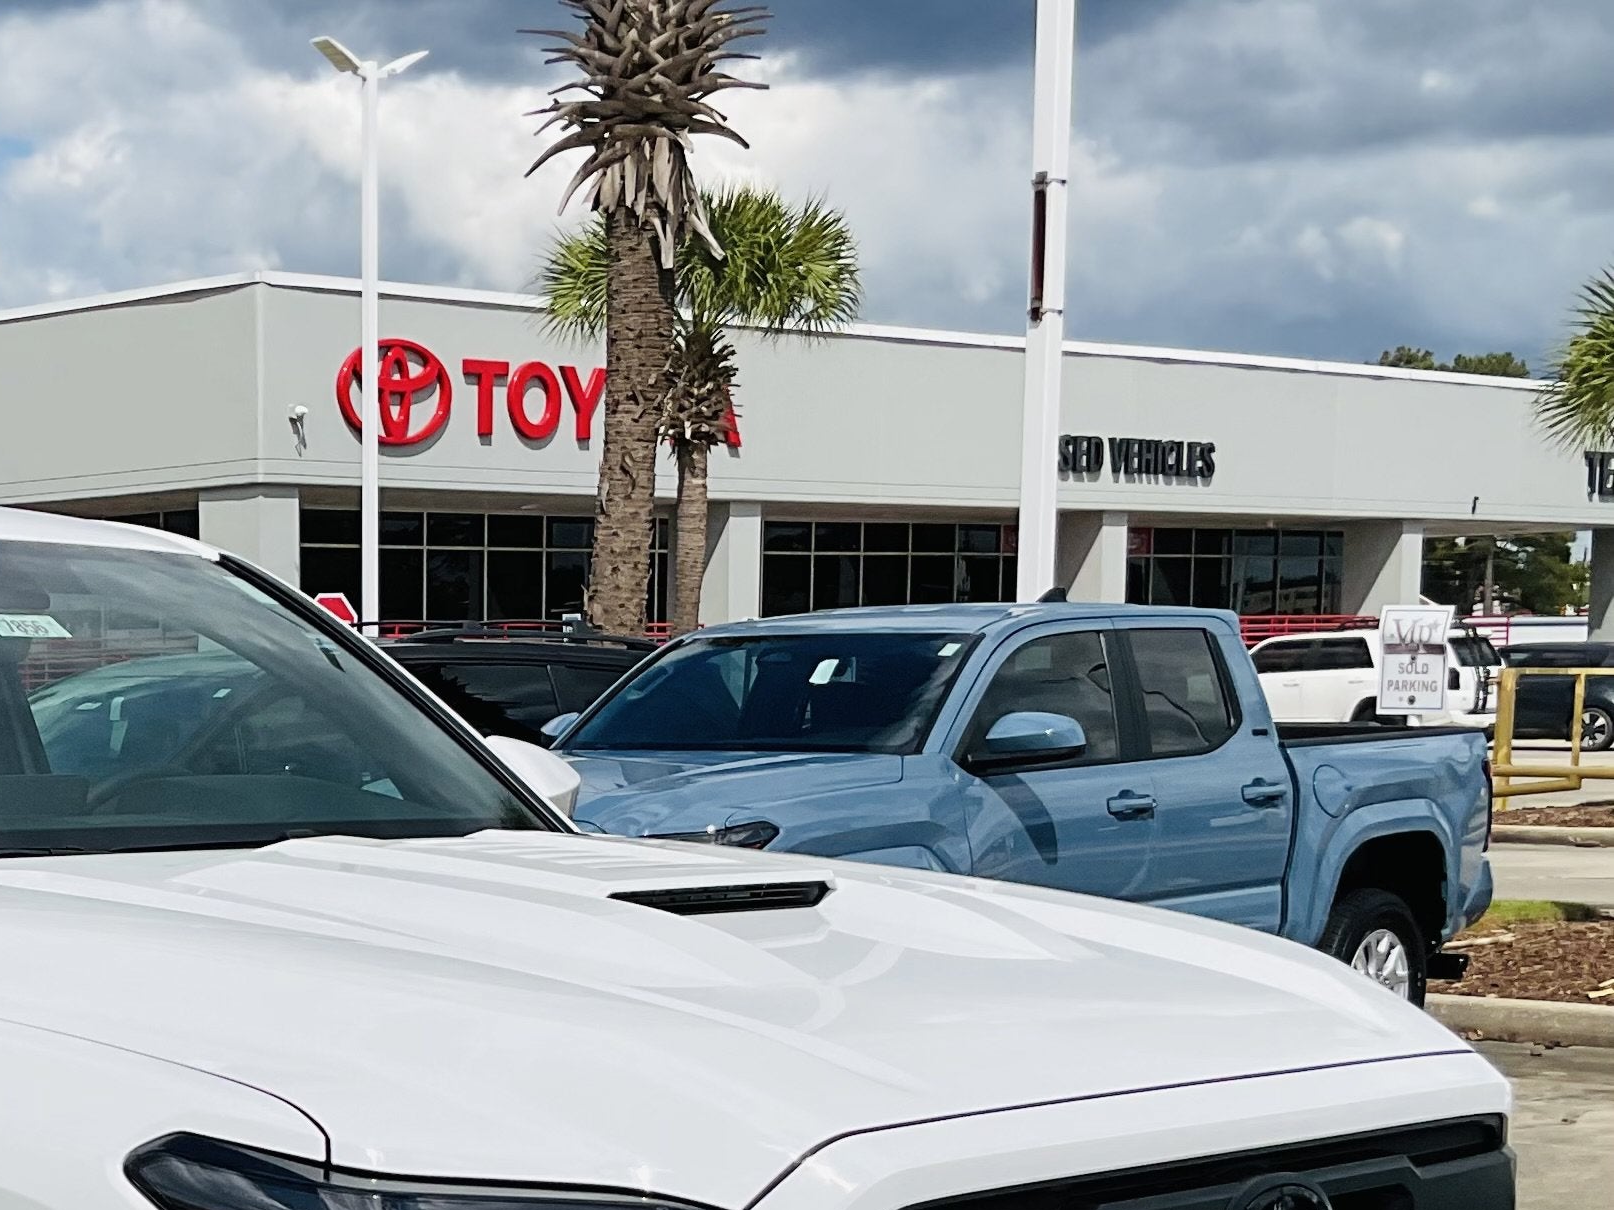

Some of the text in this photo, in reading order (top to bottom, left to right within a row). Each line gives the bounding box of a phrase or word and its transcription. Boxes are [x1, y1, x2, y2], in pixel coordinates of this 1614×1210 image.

[462, 358, 742, 447] TOY
[1058, 434, 1216, 478] SED VEHICLES
[1397, 662, 1429, 675] SOLD
[1387, 680, 1438, 693] PARKING
